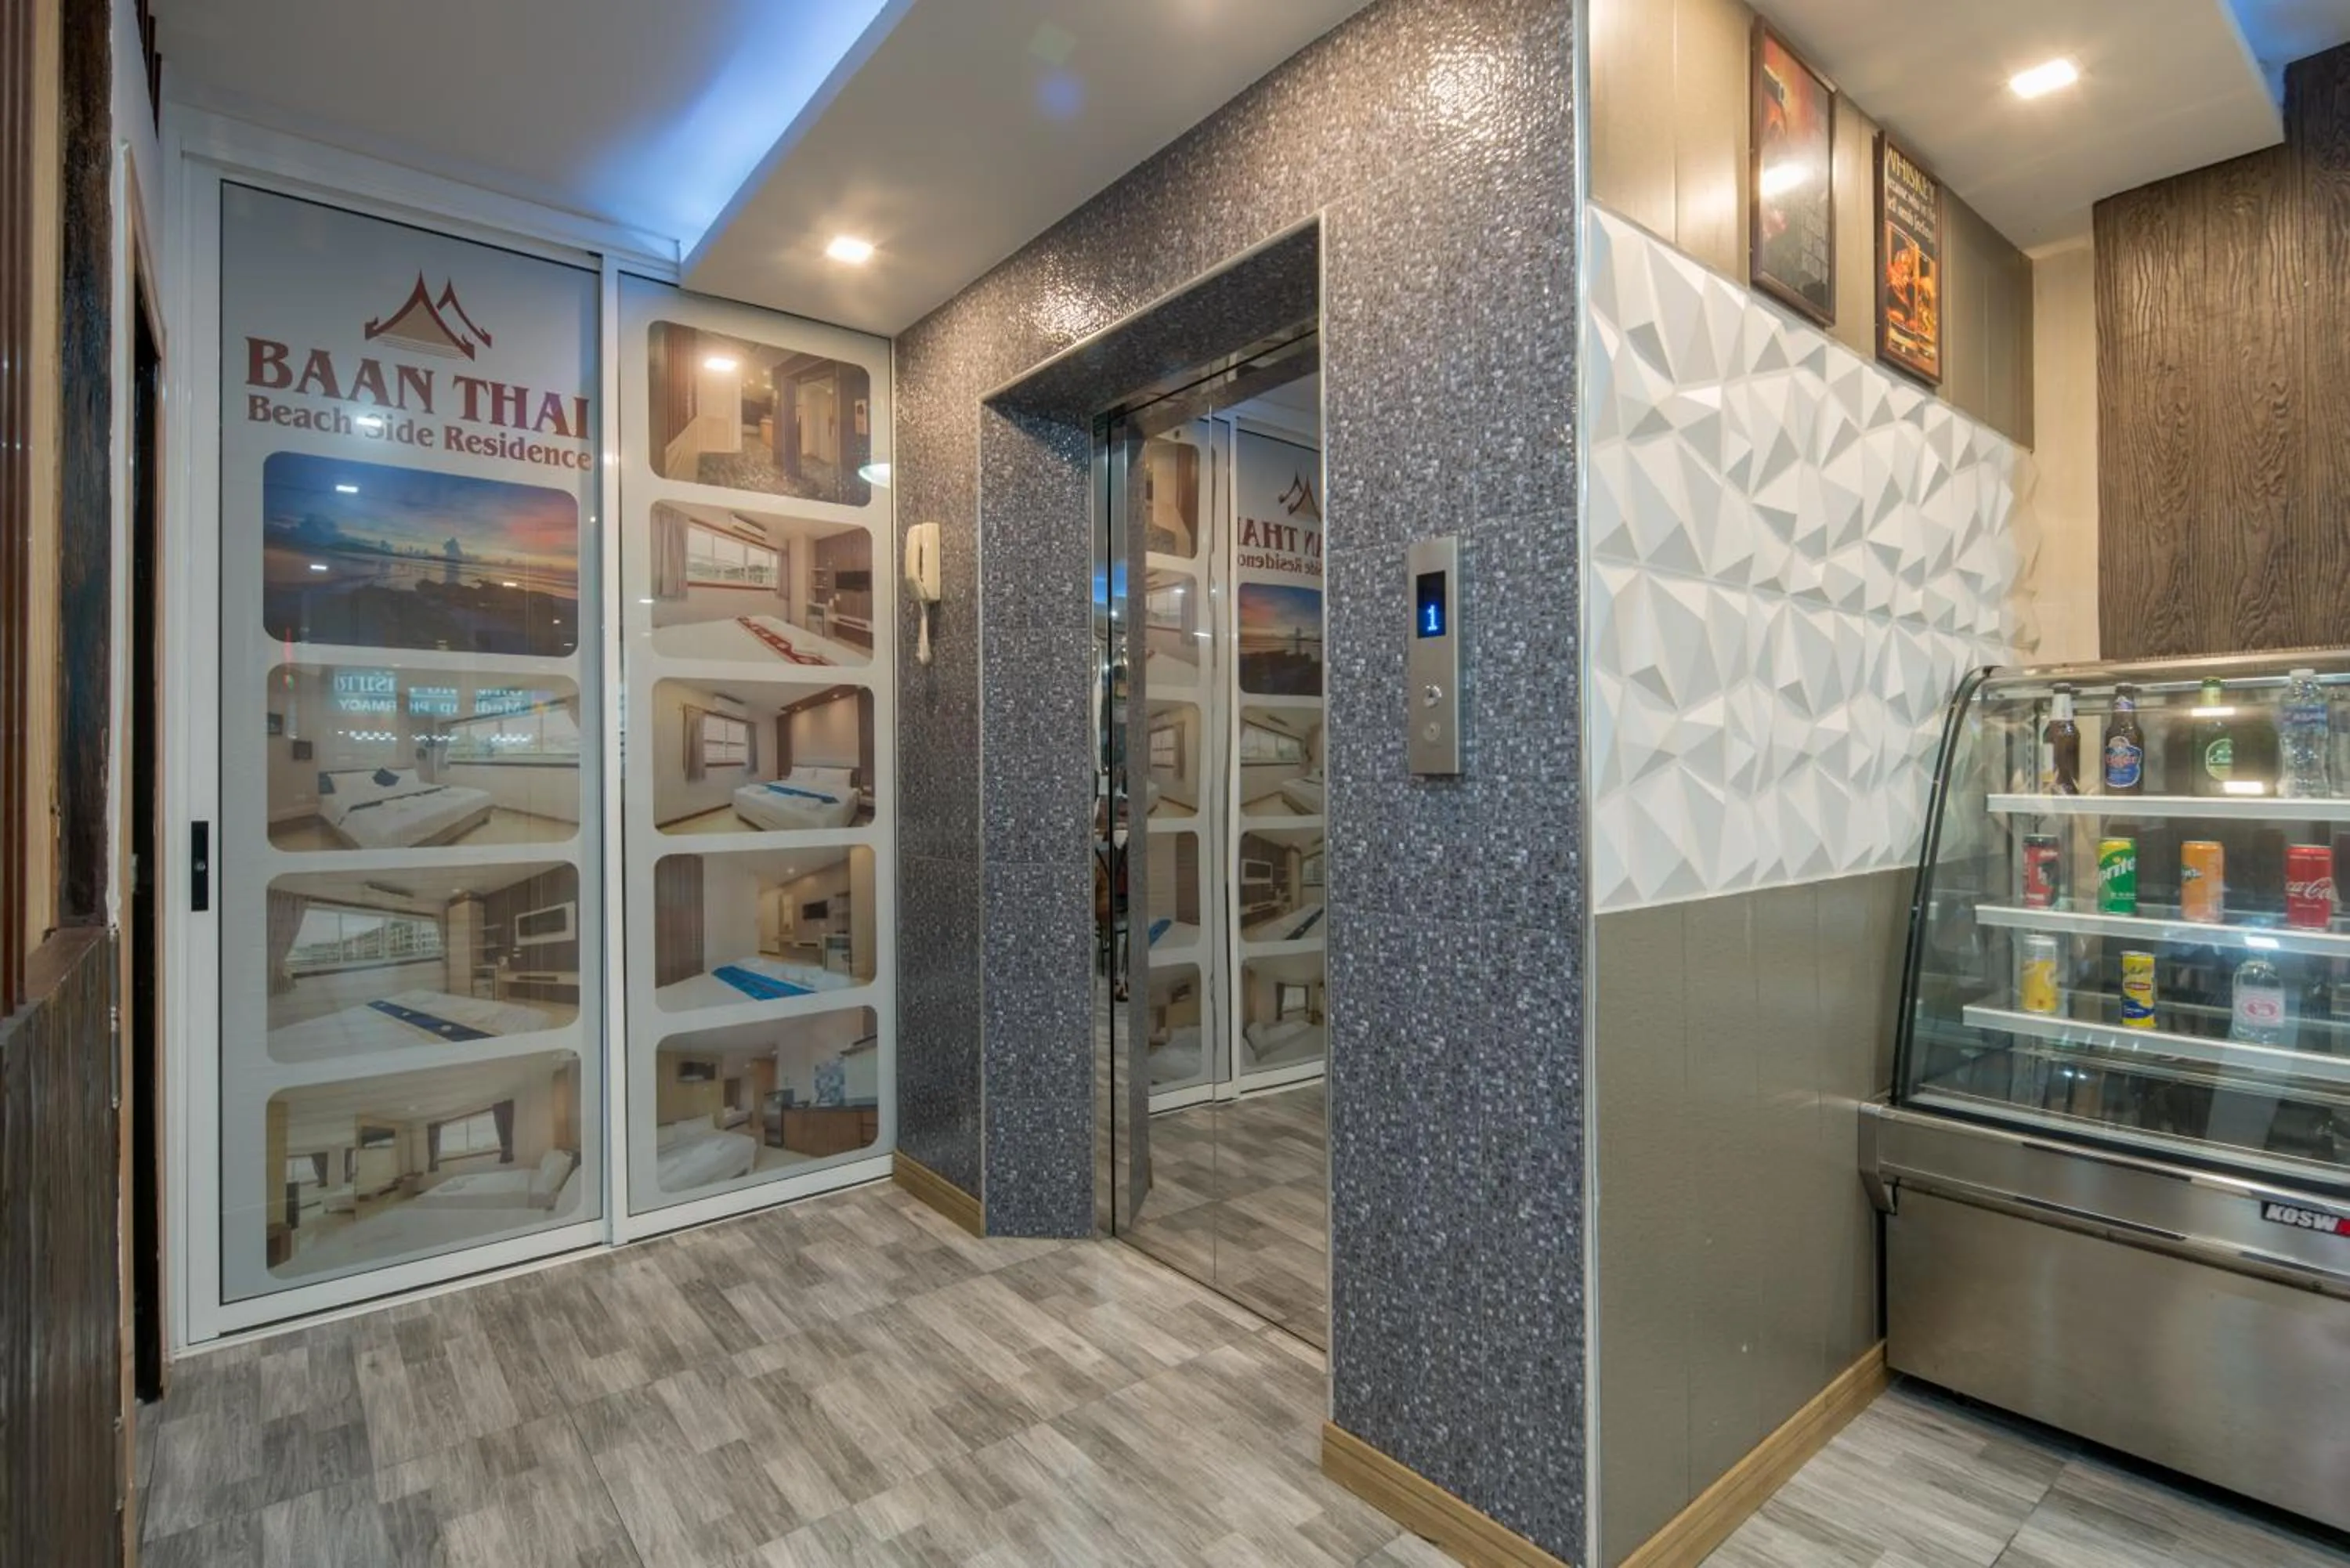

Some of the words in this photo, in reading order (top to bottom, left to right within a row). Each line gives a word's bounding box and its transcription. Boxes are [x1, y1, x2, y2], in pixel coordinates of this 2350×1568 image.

[245, 337, 435, 415] BAAN
[453, 375, 590, 439] THAI
[248, 394, 352, 435] Beach
[363, 413, 435, 447] Side
[443, 425, 592, 471] Residence
[1426, 604, 1438, 631] 1
